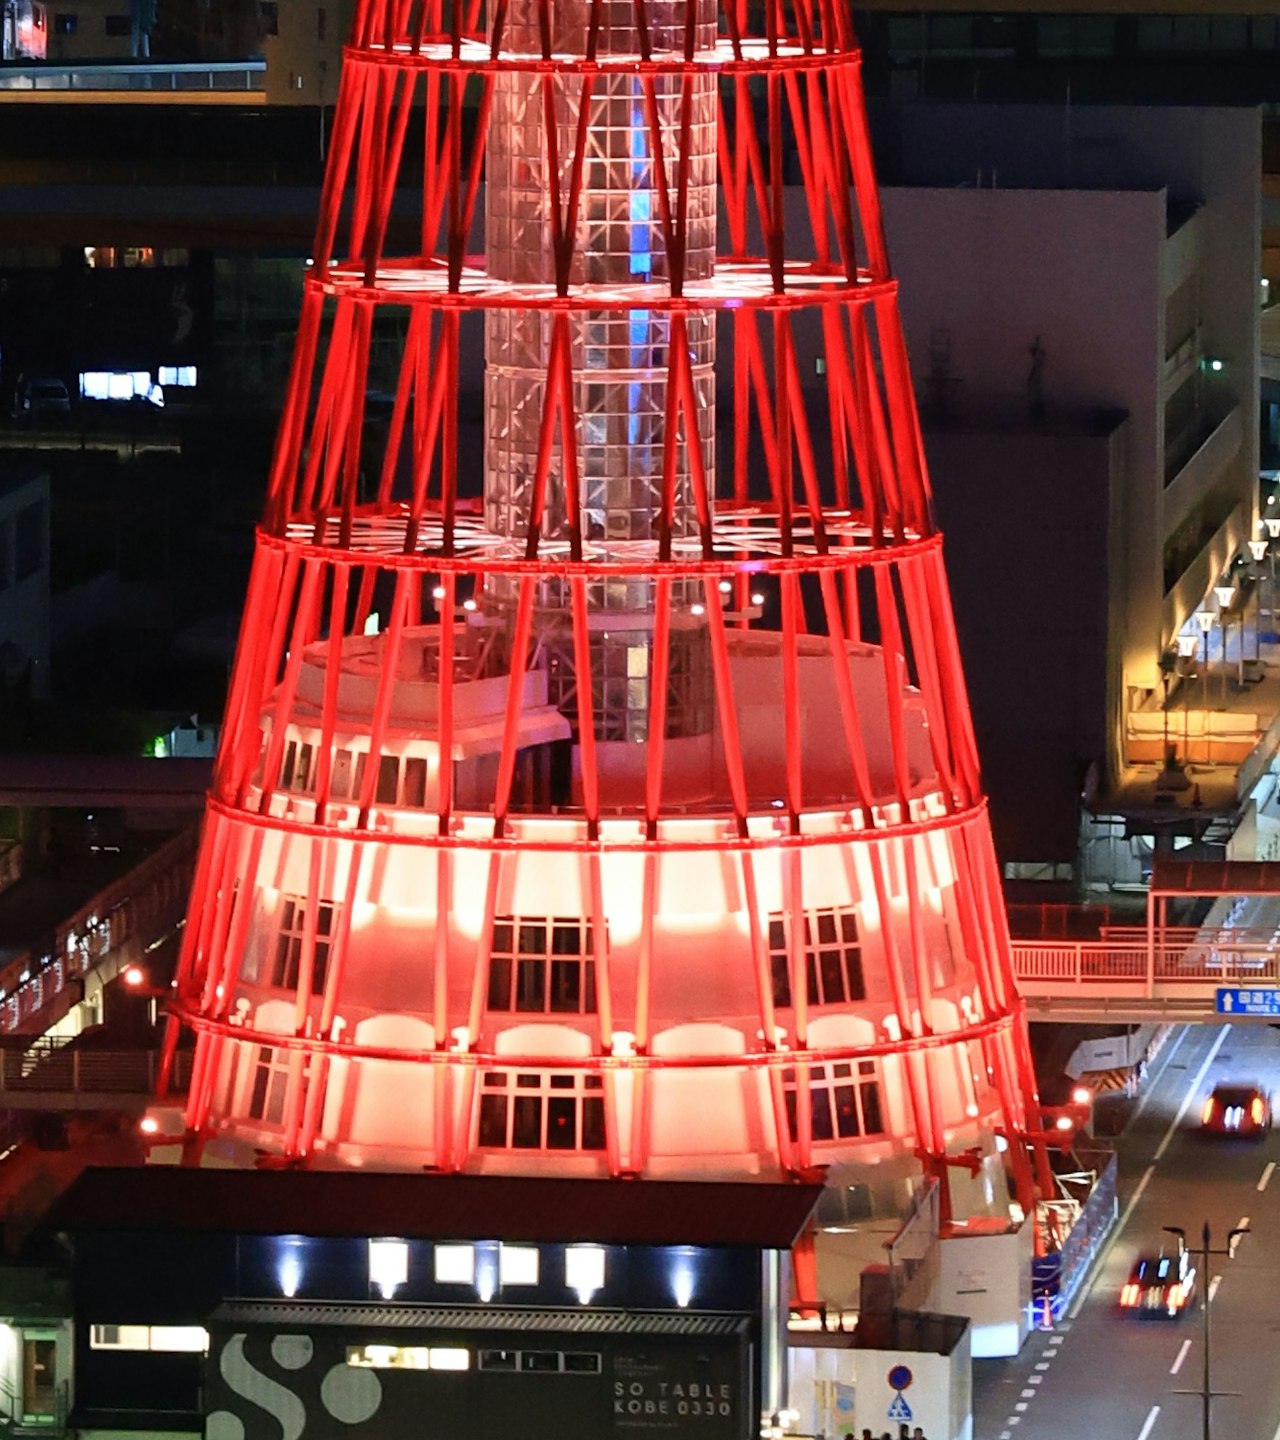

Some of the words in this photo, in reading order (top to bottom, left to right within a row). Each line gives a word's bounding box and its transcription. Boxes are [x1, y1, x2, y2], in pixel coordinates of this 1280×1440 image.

[614, 1381, 644, 1396] SO
[659, 1383, 731, 1399] TABLE
[614, 1400, 669, 1415] KOBE
[677, 1401, 731, 1416] 0330
